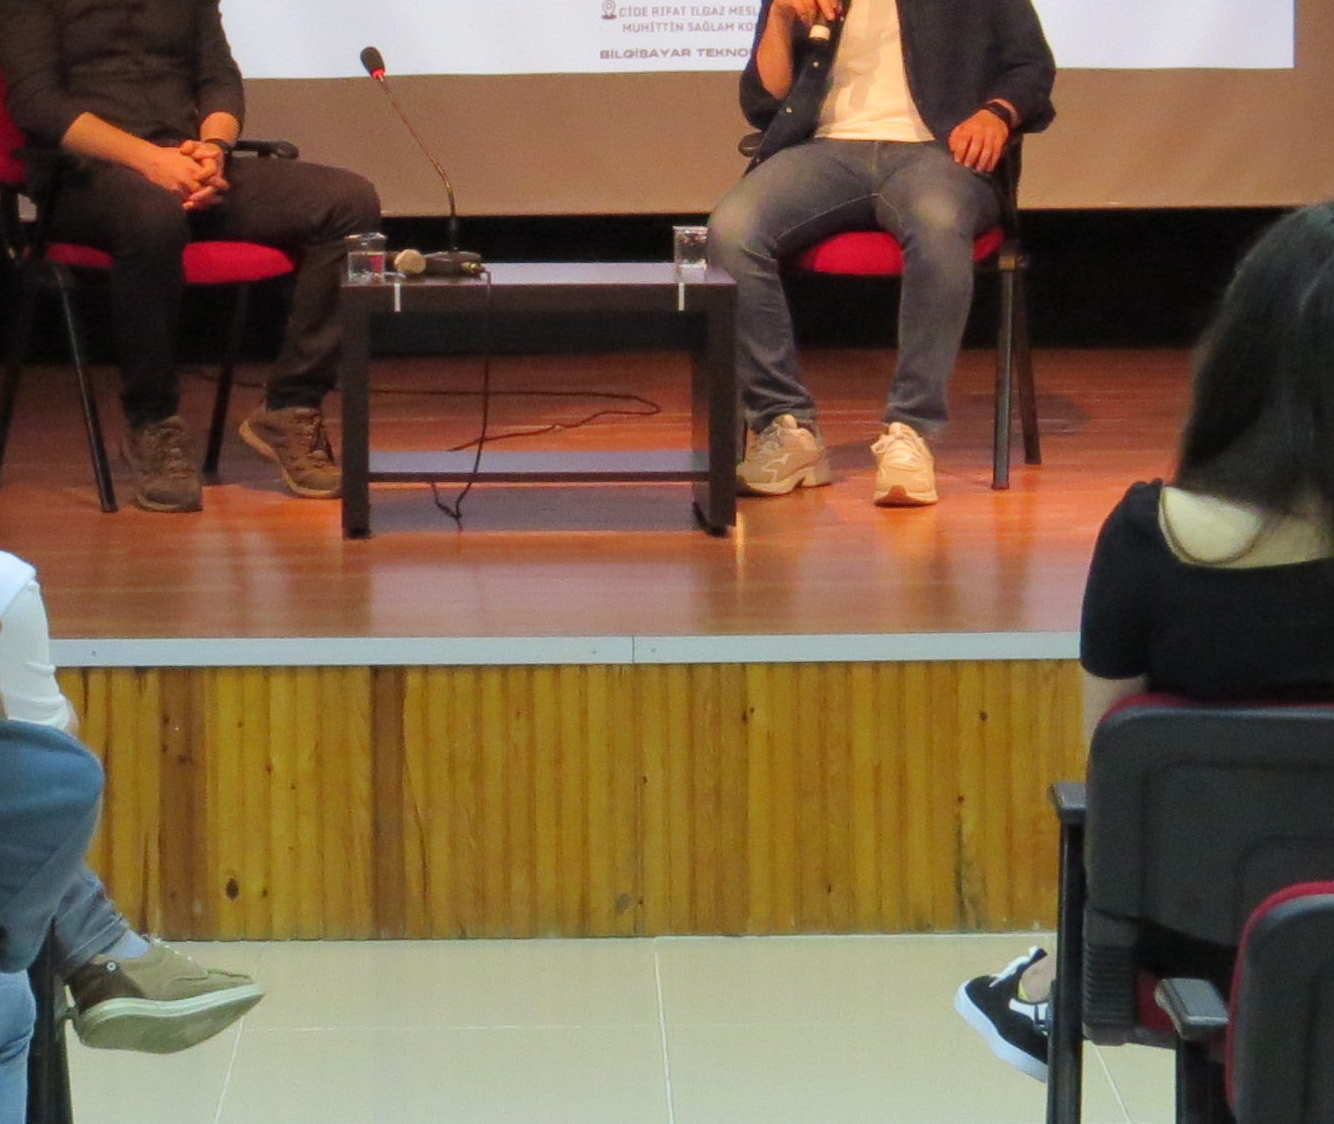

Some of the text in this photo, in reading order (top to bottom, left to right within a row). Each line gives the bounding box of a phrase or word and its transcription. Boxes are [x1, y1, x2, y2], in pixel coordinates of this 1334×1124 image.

[619, 5, 648, 18] CİDE
[690, 6, 725, 17] ILGAZ
[622, 21, 684, 33] MUHİTTİN
[688, 21, 735, 32] SAĞLAM
[599, 48, 752, 60] BİLGİSAYAR TEKNO
